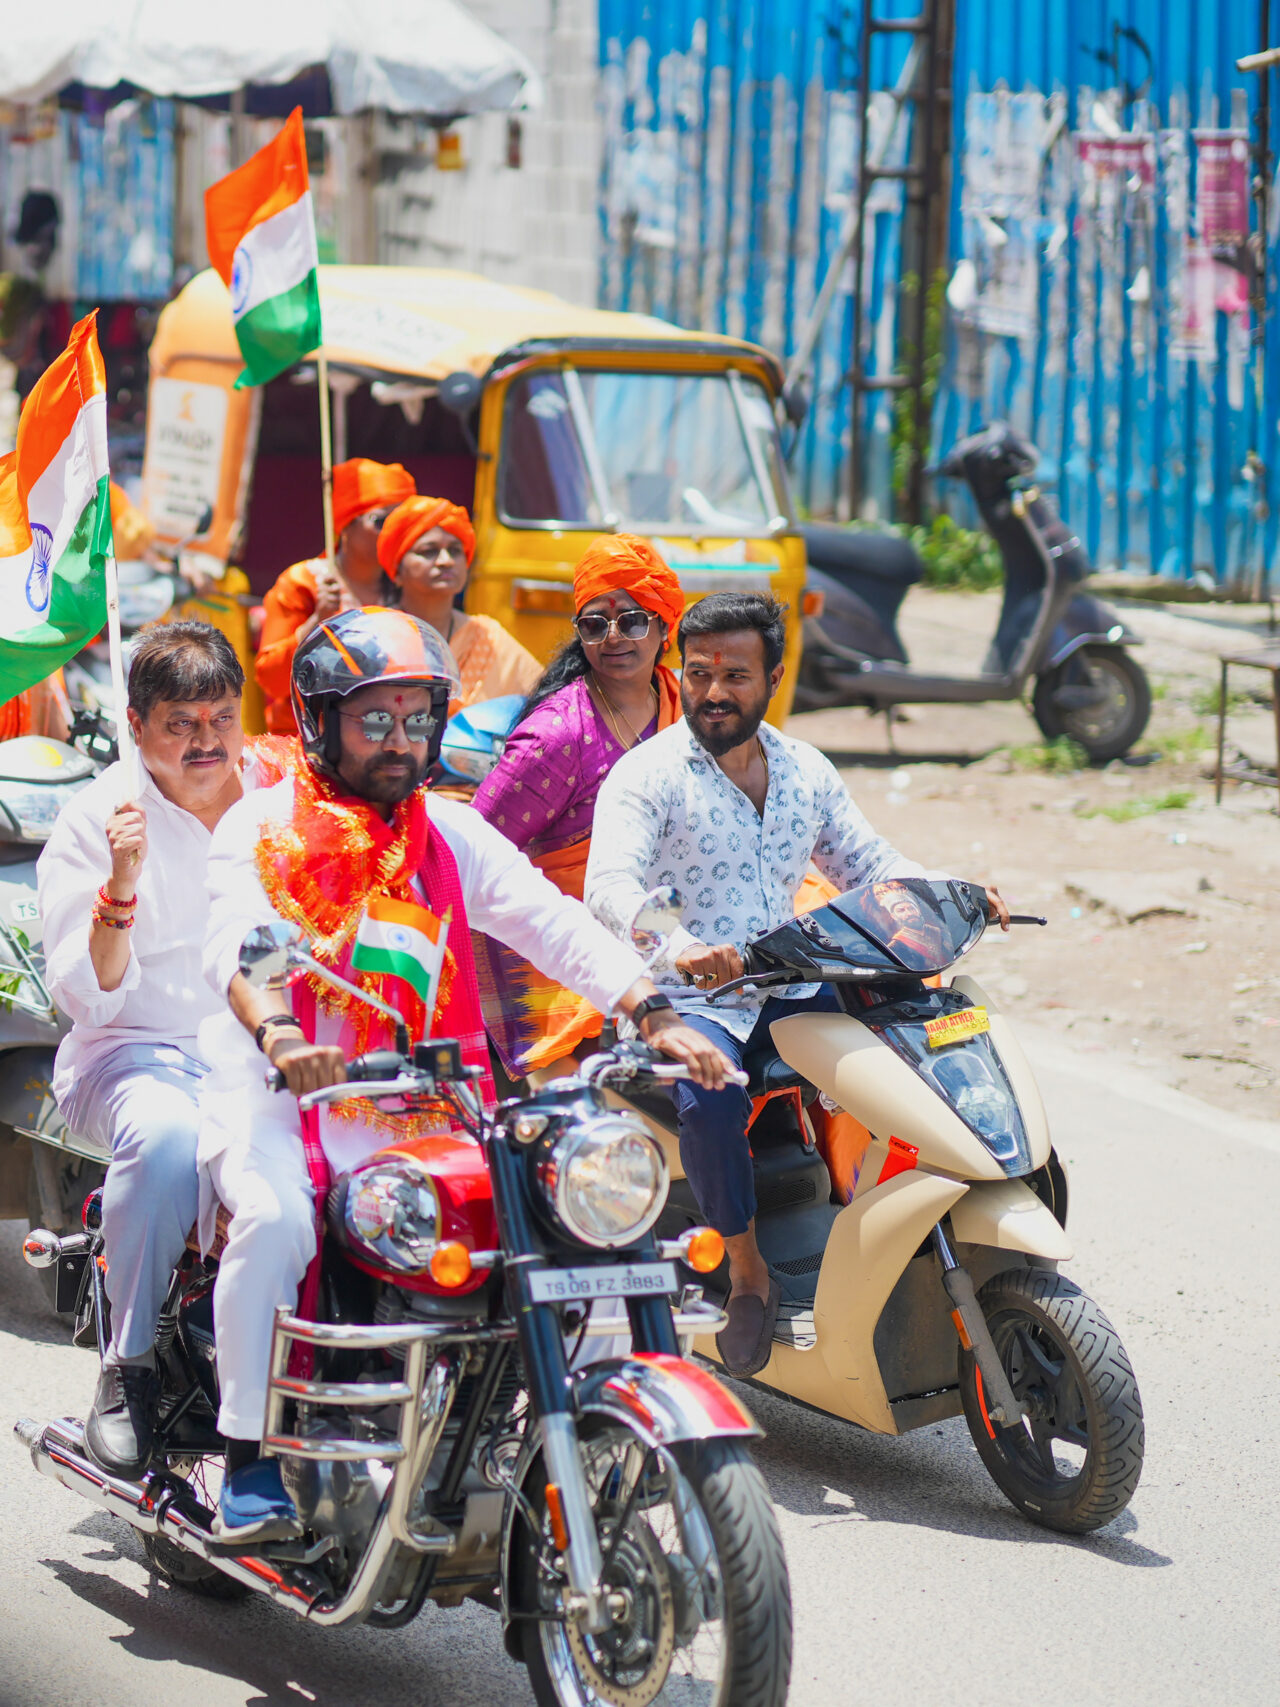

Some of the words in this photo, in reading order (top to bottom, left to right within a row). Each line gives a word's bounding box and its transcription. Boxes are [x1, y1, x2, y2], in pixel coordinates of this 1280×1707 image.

[17, 903, 38, 918] TS
[948, 1011, 976, 1027] ATHER
[545, 1281, 566, 1296] TS
[569, 1279, 591, 1294] 09
[596, 1277, 617, 1292] FZ
[621, 1274, 665, 1290] 3883
